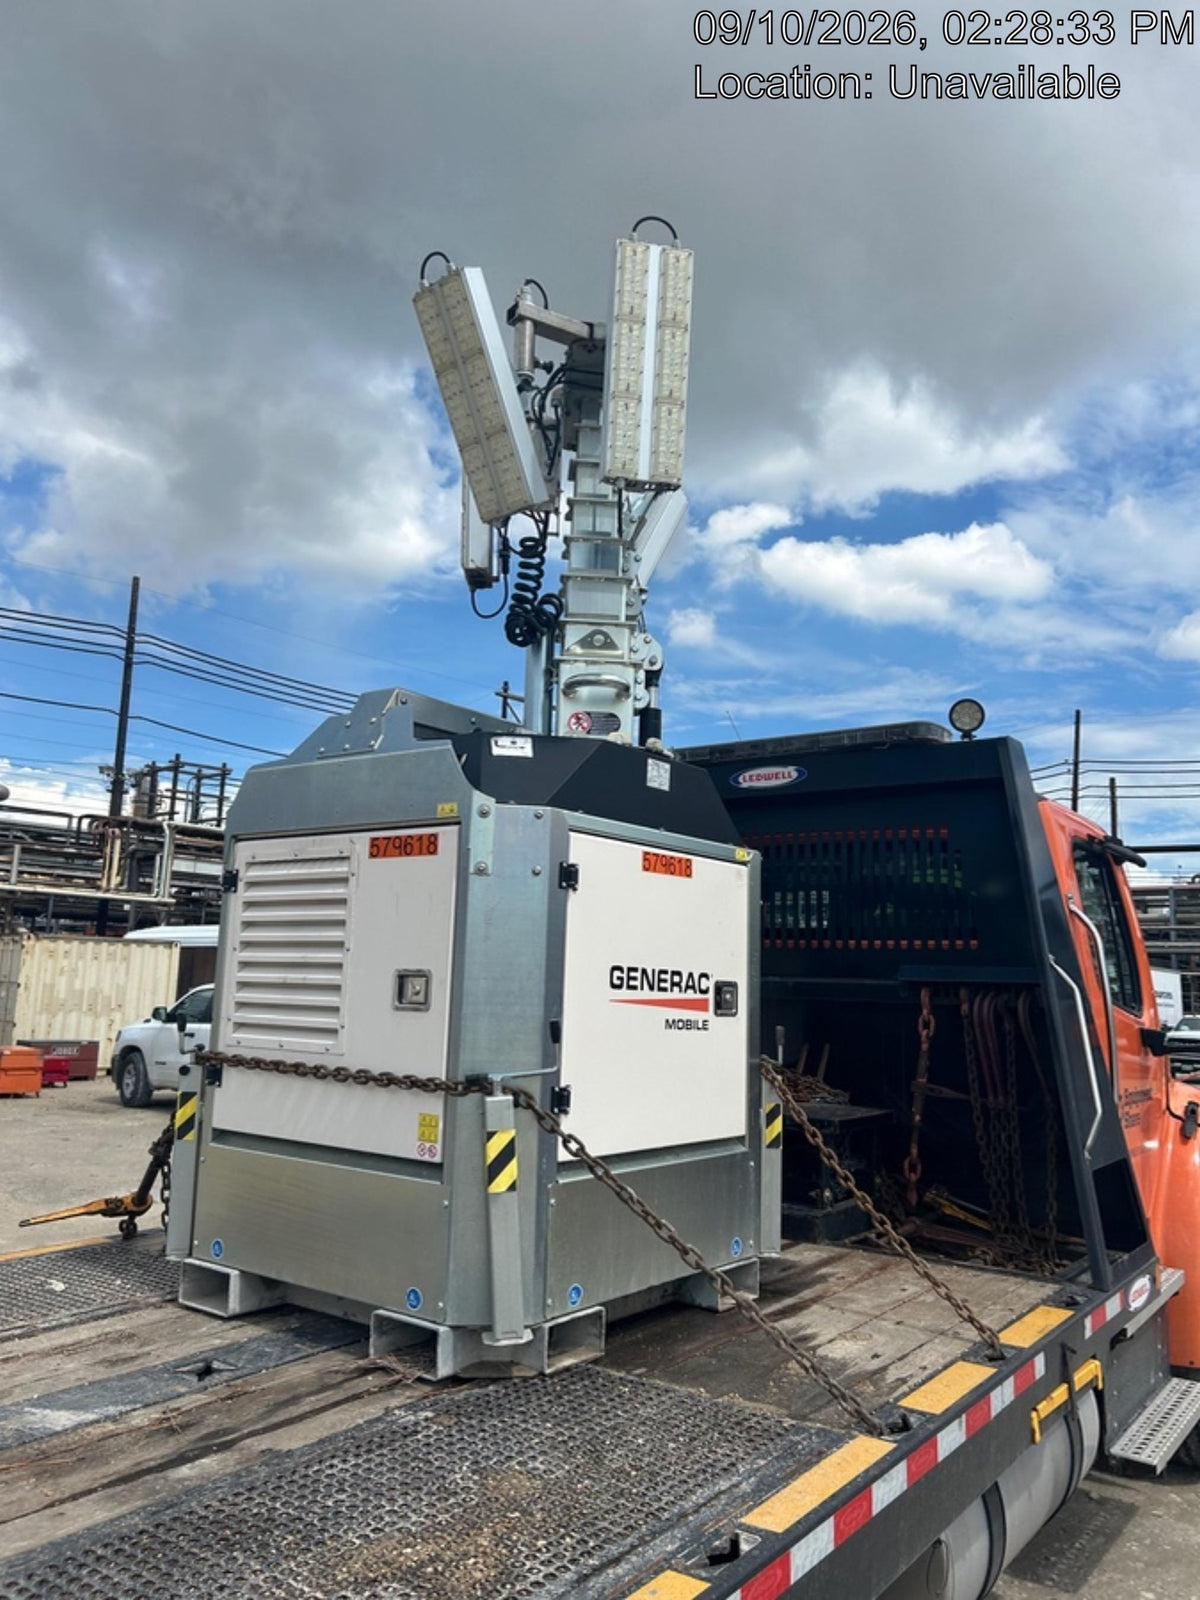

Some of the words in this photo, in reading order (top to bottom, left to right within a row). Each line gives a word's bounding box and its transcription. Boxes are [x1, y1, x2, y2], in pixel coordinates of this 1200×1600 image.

[742, 770, 794, 783] LEDWELL
[369, 833, 438, 858] 579618
[642, 852, 692, 877] 579618
[609, 965, 710, 995] GENERAC
[664, 1018, 710, 1031] MOBILE
